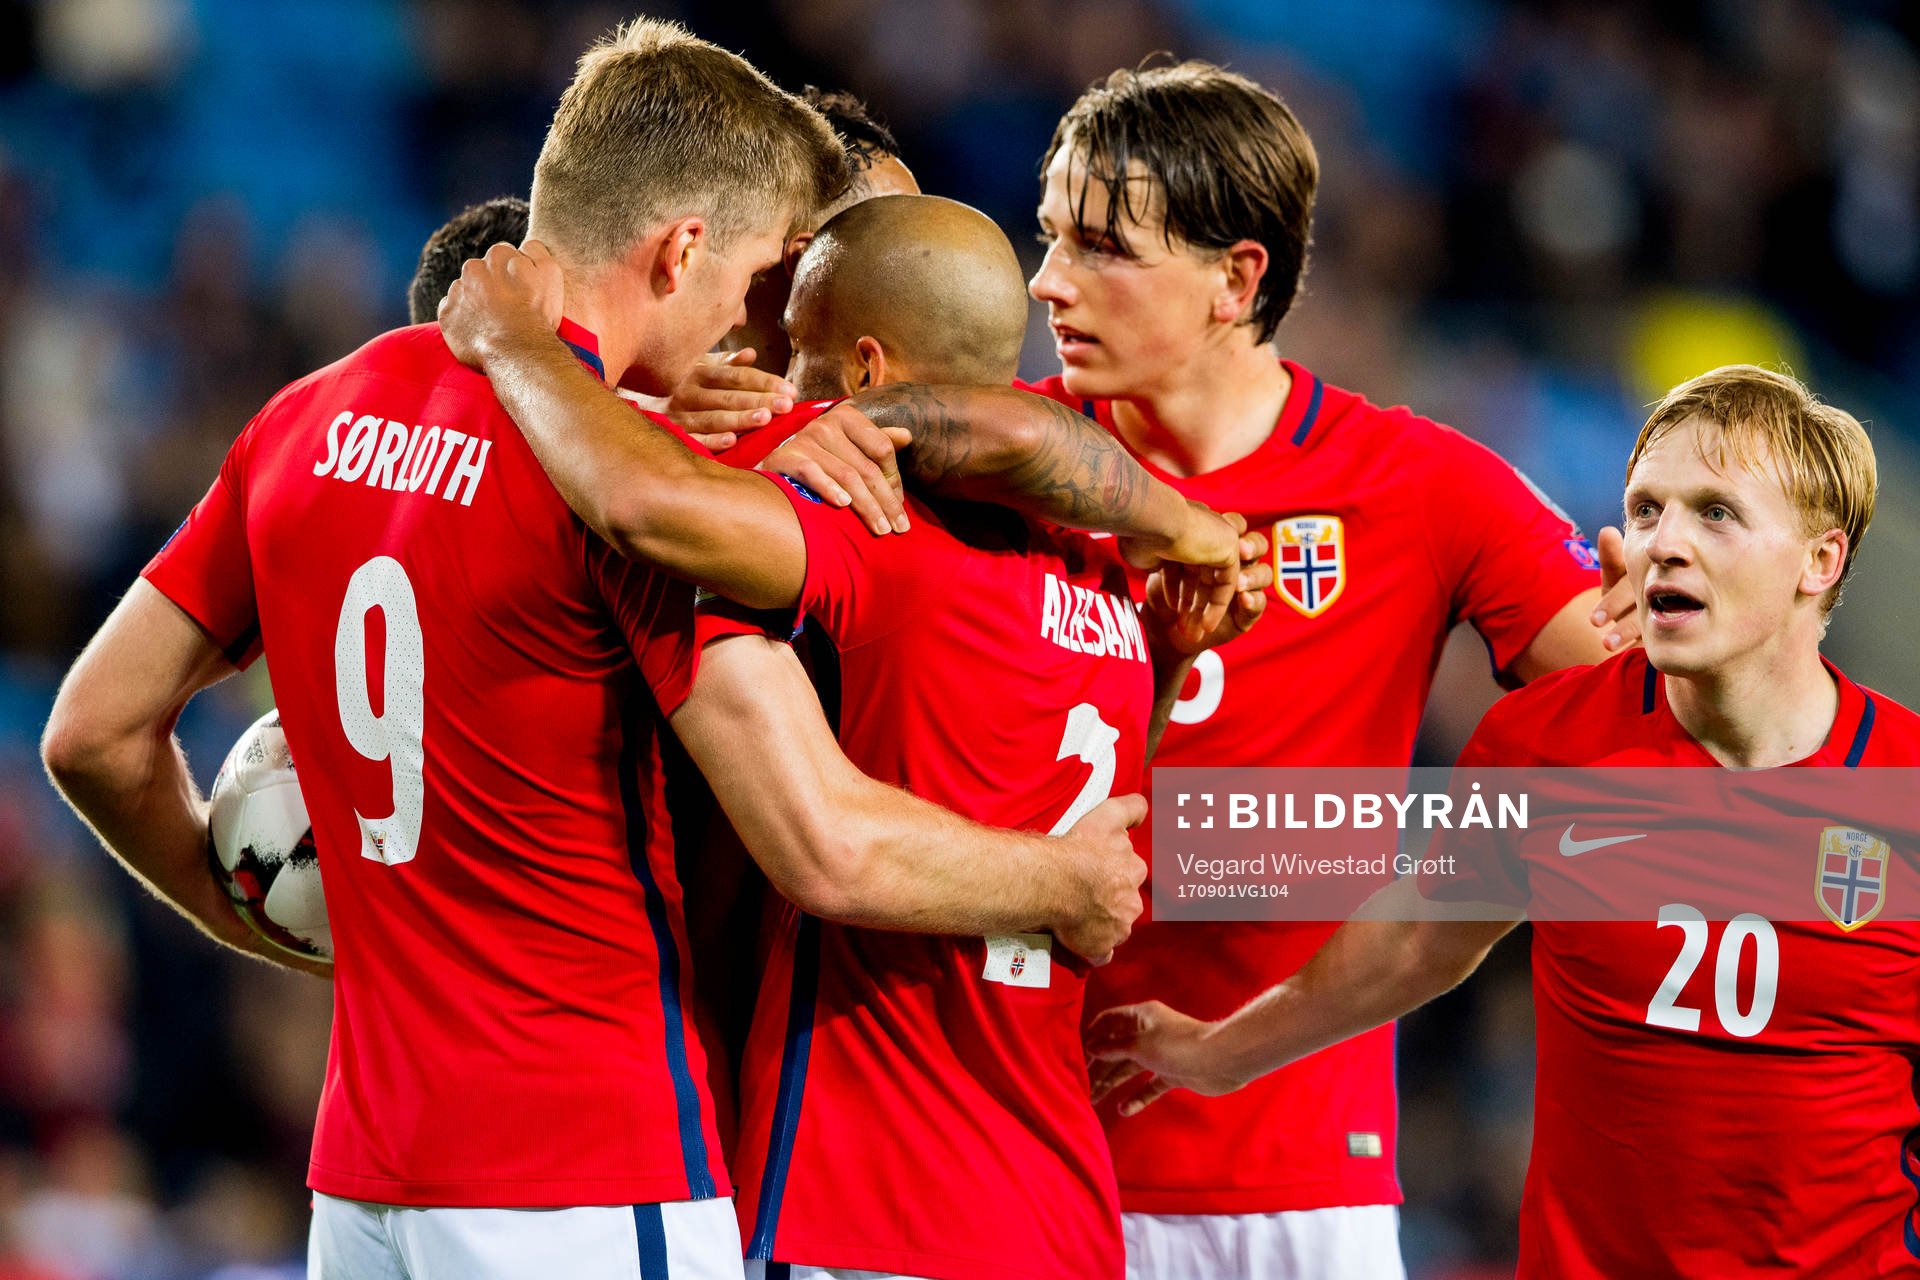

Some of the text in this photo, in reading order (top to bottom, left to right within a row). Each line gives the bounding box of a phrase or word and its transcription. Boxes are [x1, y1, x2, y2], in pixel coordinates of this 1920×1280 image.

[313, 410, 492, 507] SØRLOTH
[334, 555, 424, 866] 9
[1845, 831, 1868, 842] NORGE
[1645, 903, 1780, 1038] 20
